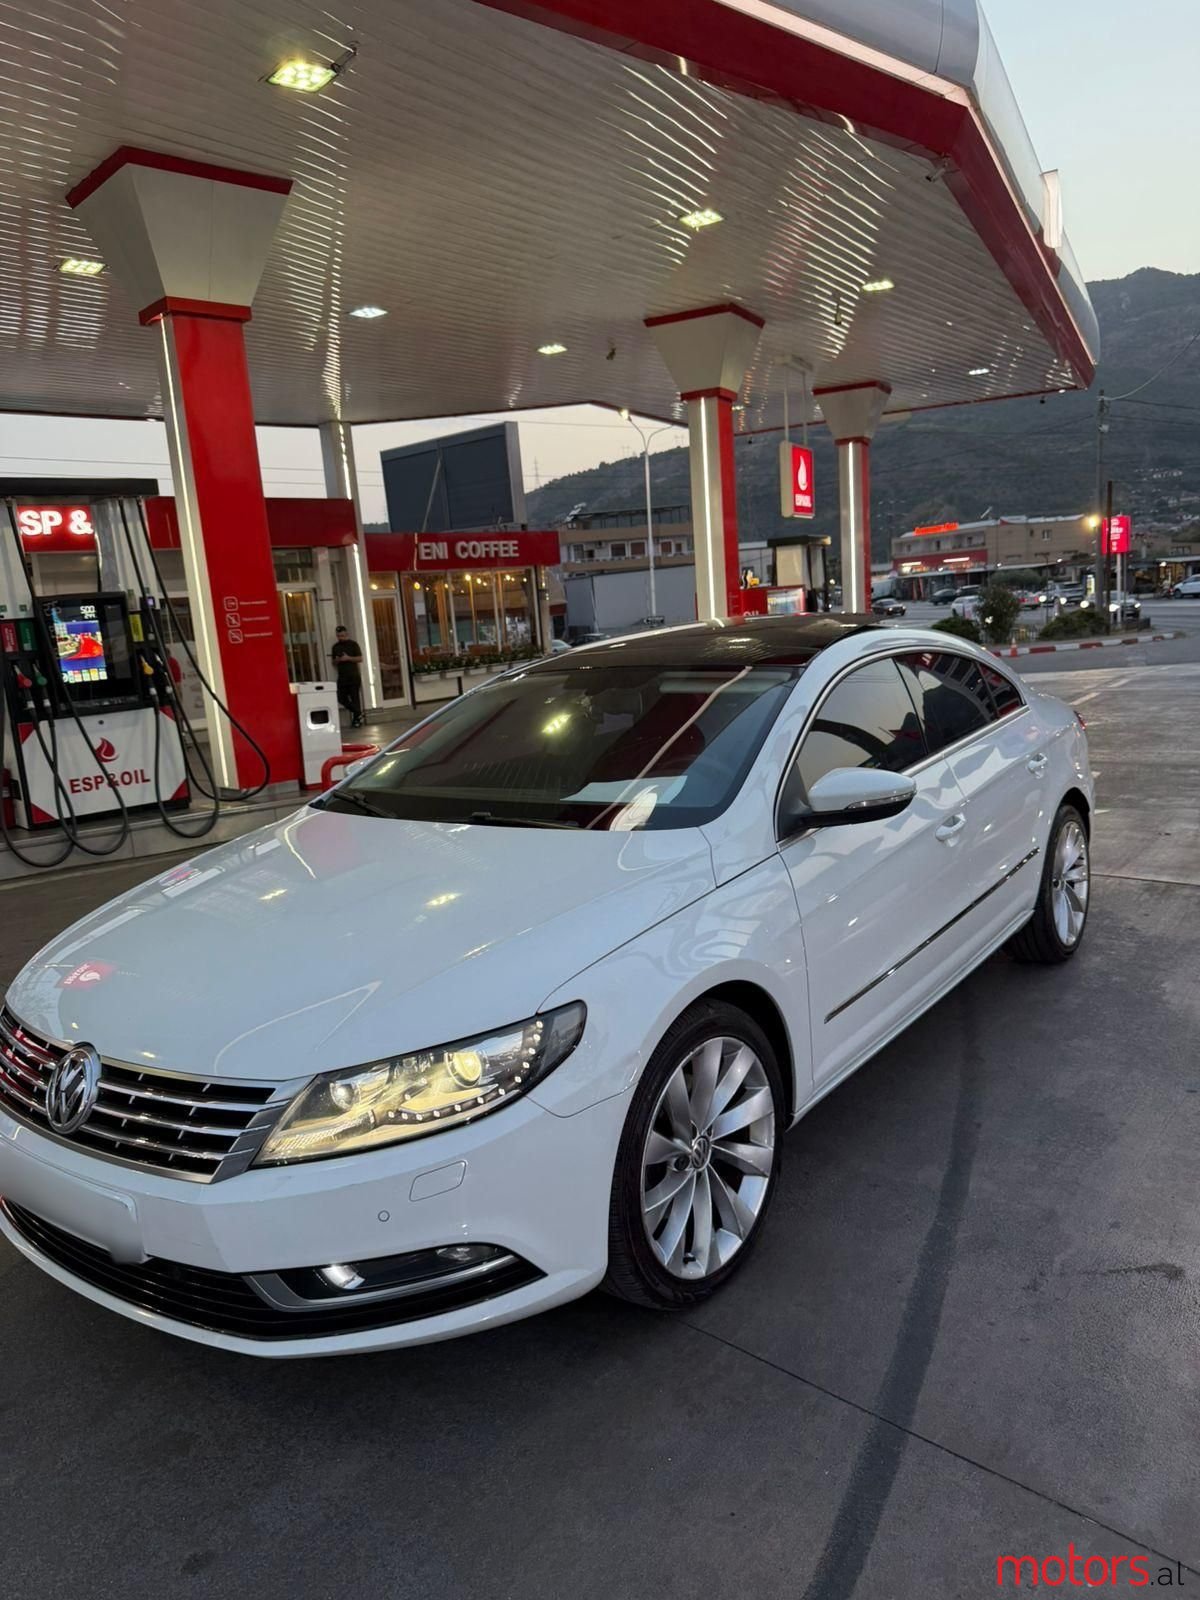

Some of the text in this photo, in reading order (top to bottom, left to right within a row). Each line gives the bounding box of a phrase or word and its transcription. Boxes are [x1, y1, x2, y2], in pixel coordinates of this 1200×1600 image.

[19, 510, 94, 536] SP &
[420, 540, 519, 560] ENI COFFEE
